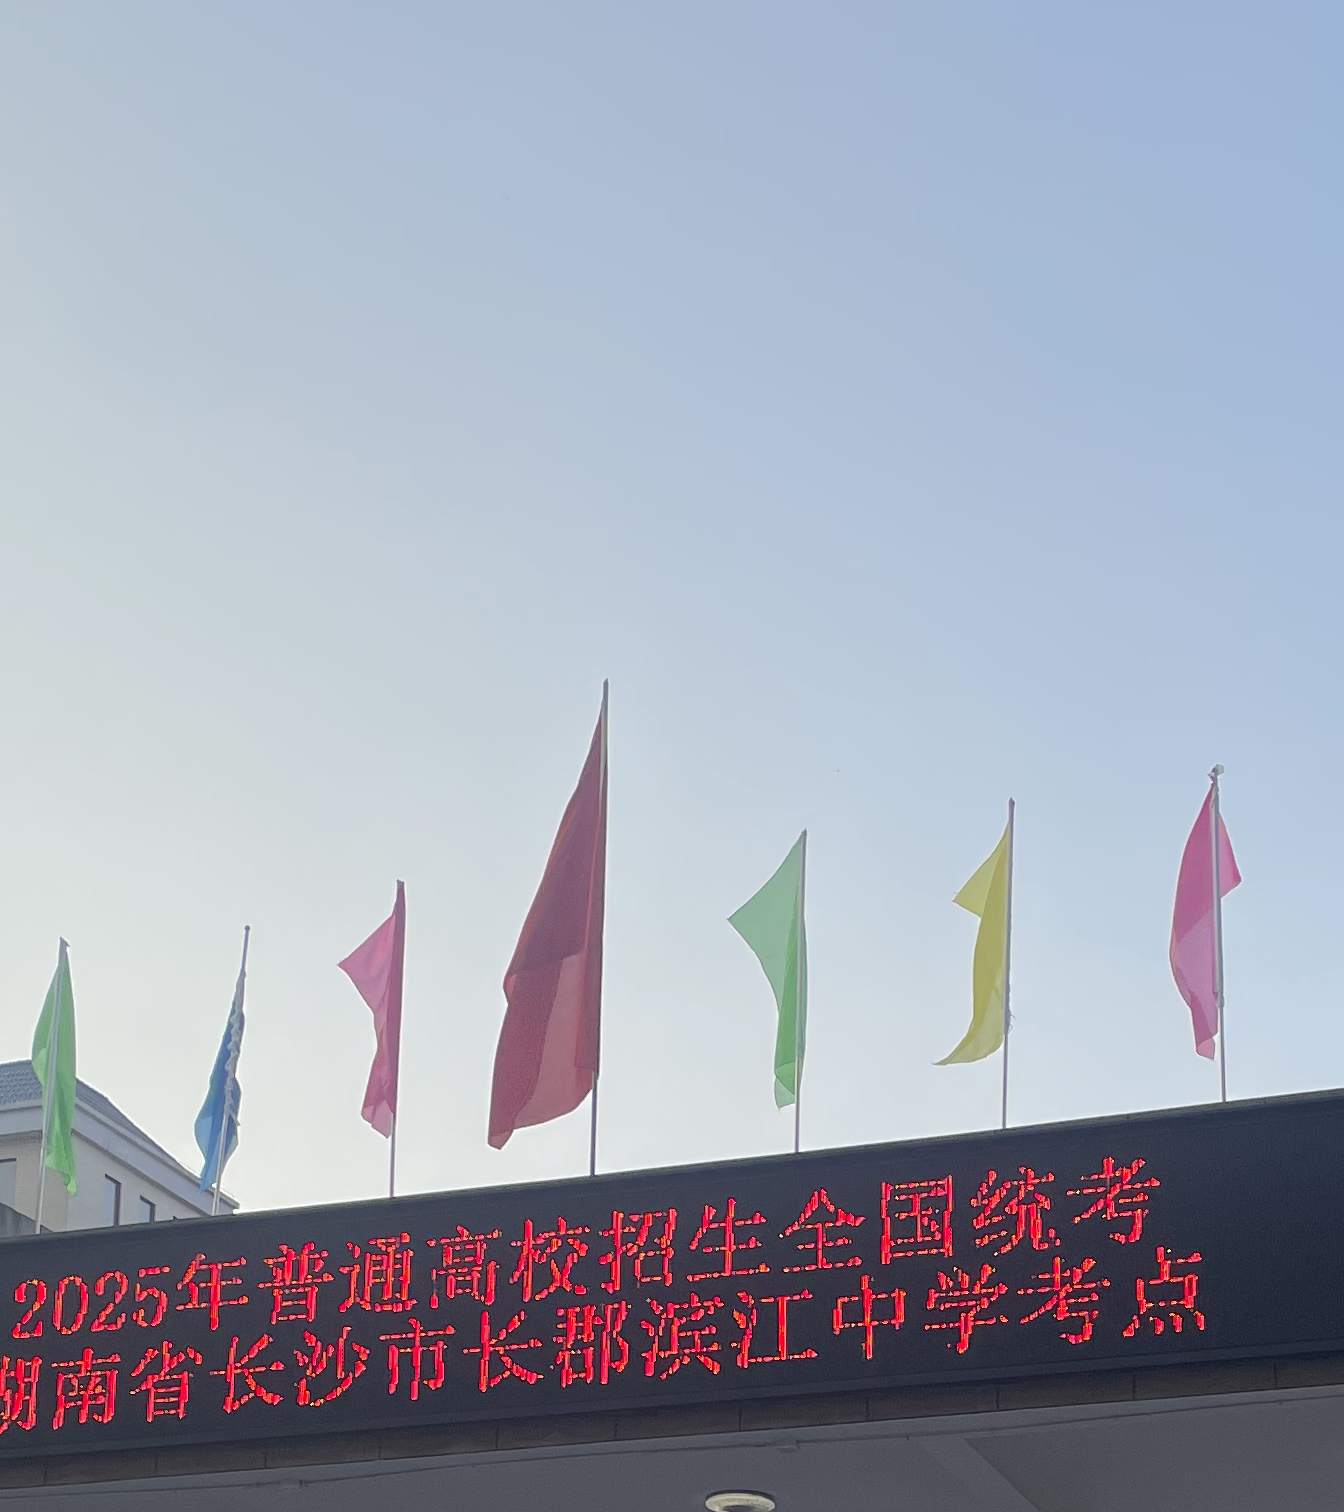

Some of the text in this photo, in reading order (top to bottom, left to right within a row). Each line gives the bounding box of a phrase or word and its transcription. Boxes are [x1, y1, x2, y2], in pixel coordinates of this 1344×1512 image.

[11, 1157, 1161, 1339] 2025年普通高校招生全国统考
